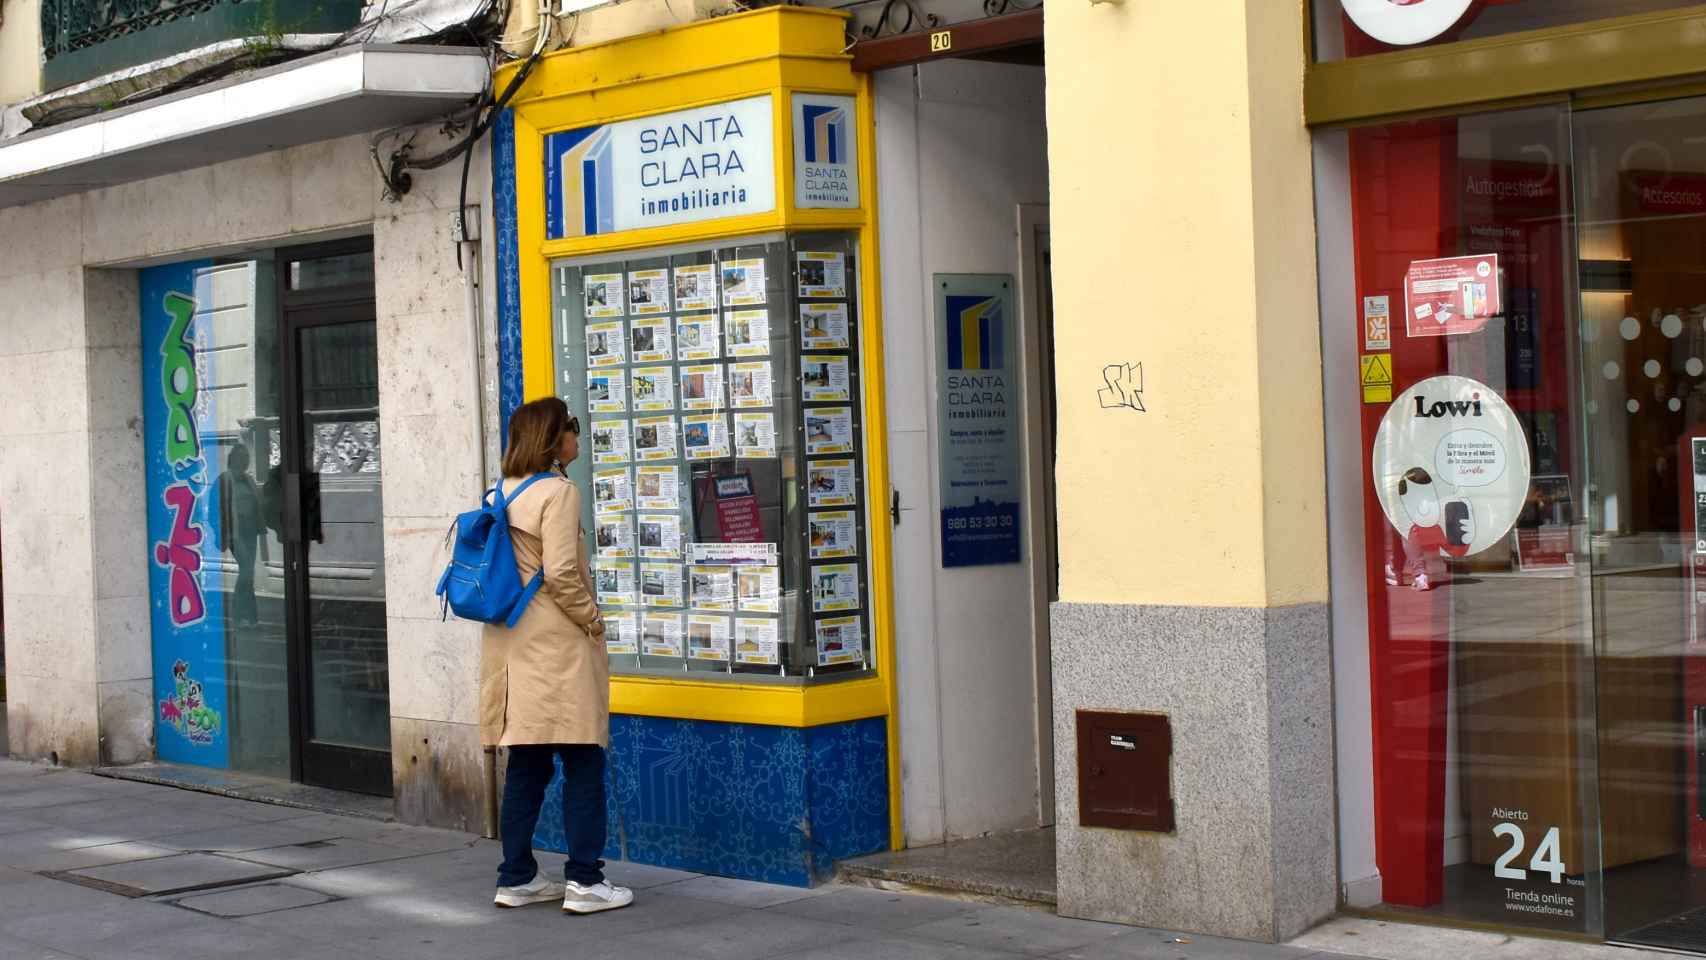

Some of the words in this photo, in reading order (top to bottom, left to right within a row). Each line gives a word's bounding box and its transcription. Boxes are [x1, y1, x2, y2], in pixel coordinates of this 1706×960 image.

[933, 33, 949, 49] 20
[640, 114, 744, 154] SANTA
[641, 149, 745, 188] CLARA
[804, 166, 848, 179] SANTA
[804, 179, 848, 191] CLARA
[641, 185, 747, 216] inmobiliaria
[805, 192, 849, 203] inmobiliaria
[1642, 186, 1704, 206] Accesorios
[1512, 313, 1529, 332] 13
[160, 290, 202, 466] DON
[948, 376, 1004, 389] SANTA
[948, 391, 1005, 405] CLARA
[1414, 392, 1482, 418] Lowi
[949, 408, 1006, 419] inmobiliaria
[172, 455, 208, 498] &
[947, 517, 967, 530] 980
[969, 516, 982, 529] 53
[984, 515, 998, 528] 30
[999, 514, 1013, 527] 30
[1491, 807, 1529, 820] Abierto
[1492, 822, 1565, 884] 24
[1505, 887, 1540, 902] Tienda
[1541, 893, 1575, 906] online
[1505, 902, 1575, 917] www.vodafone.es
